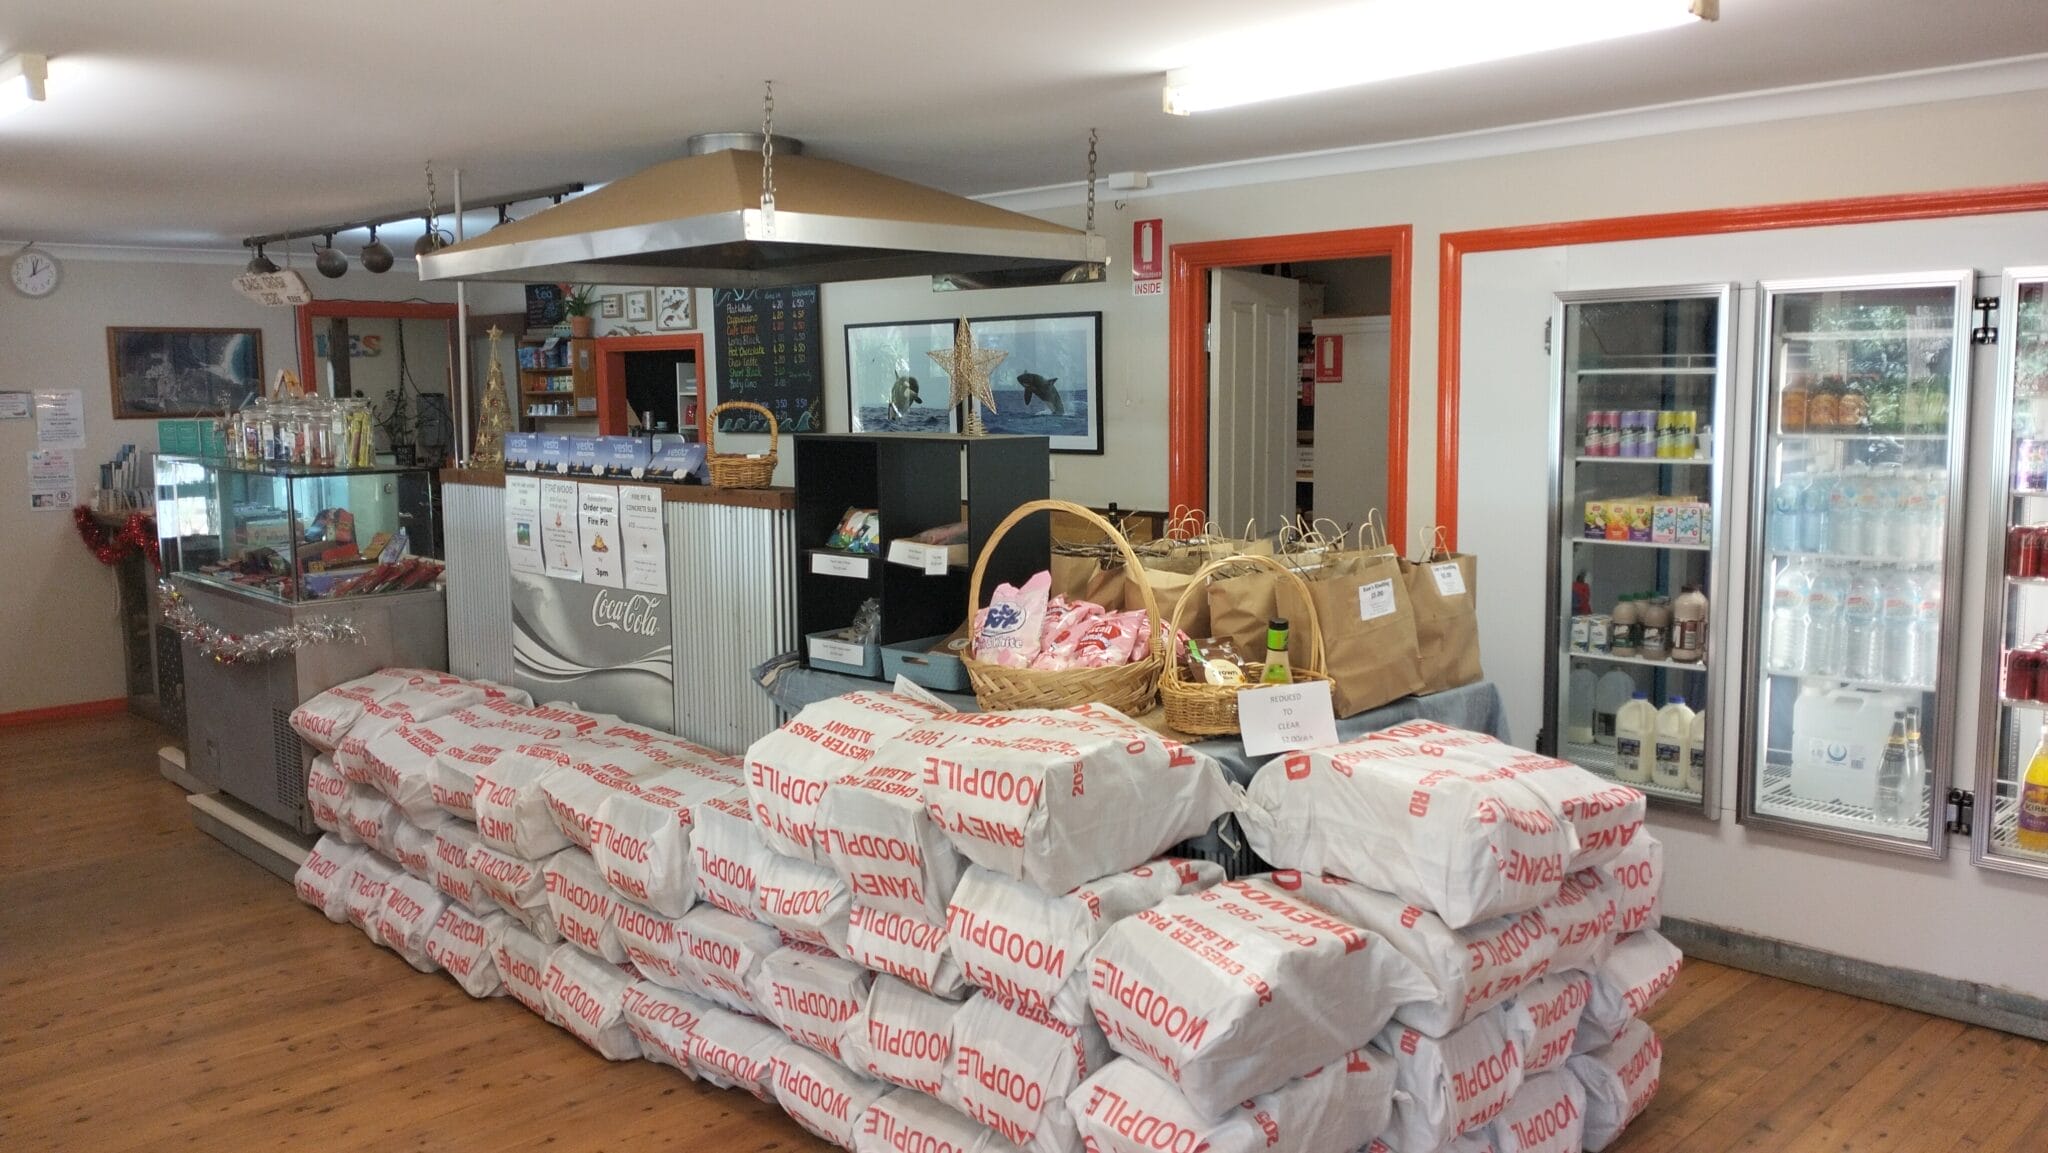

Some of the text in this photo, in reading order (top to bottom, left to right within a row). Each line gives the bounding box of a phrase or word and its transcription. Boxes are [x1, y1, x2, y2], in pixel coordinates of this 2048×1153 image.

[1134, 282, 1161, 295] INSIDE
[511, 437, 527, 448] vesta
[542, 439, 559, 449] vesta
[575, 440, 595, 451] vesta
[612, 442, 633, 453] vesta
[583, 503, 599, 511] Order
[588, 516, 609, 526] Fire Pit
[595, 567, 609, 578] 3pm
[1269, 692, 1301, 704] REDUCED
[1282, 707, 1293, 716] TO
[822, 720, 875, 744] ALBANY
[1277, 721, 1300, 731] CLEAR
[864, 765, 916, 782] ALBANY
[1408, 790, 1431, 818] RD
[812, 828, 924, 868] WOODPILE
[1216, 902, 1263, 923] 966
[1400, 905, 1424, 929] RD
[1169, 912, 1240, 953] ALBANY
[1169, 927, 1246, 978] CHESTER
[772, 982, 860, 1023] WOODPILE
[1091, 957, 1210, 1050] WOODPILE
[1400, 1029, 1422, 1056] RD
